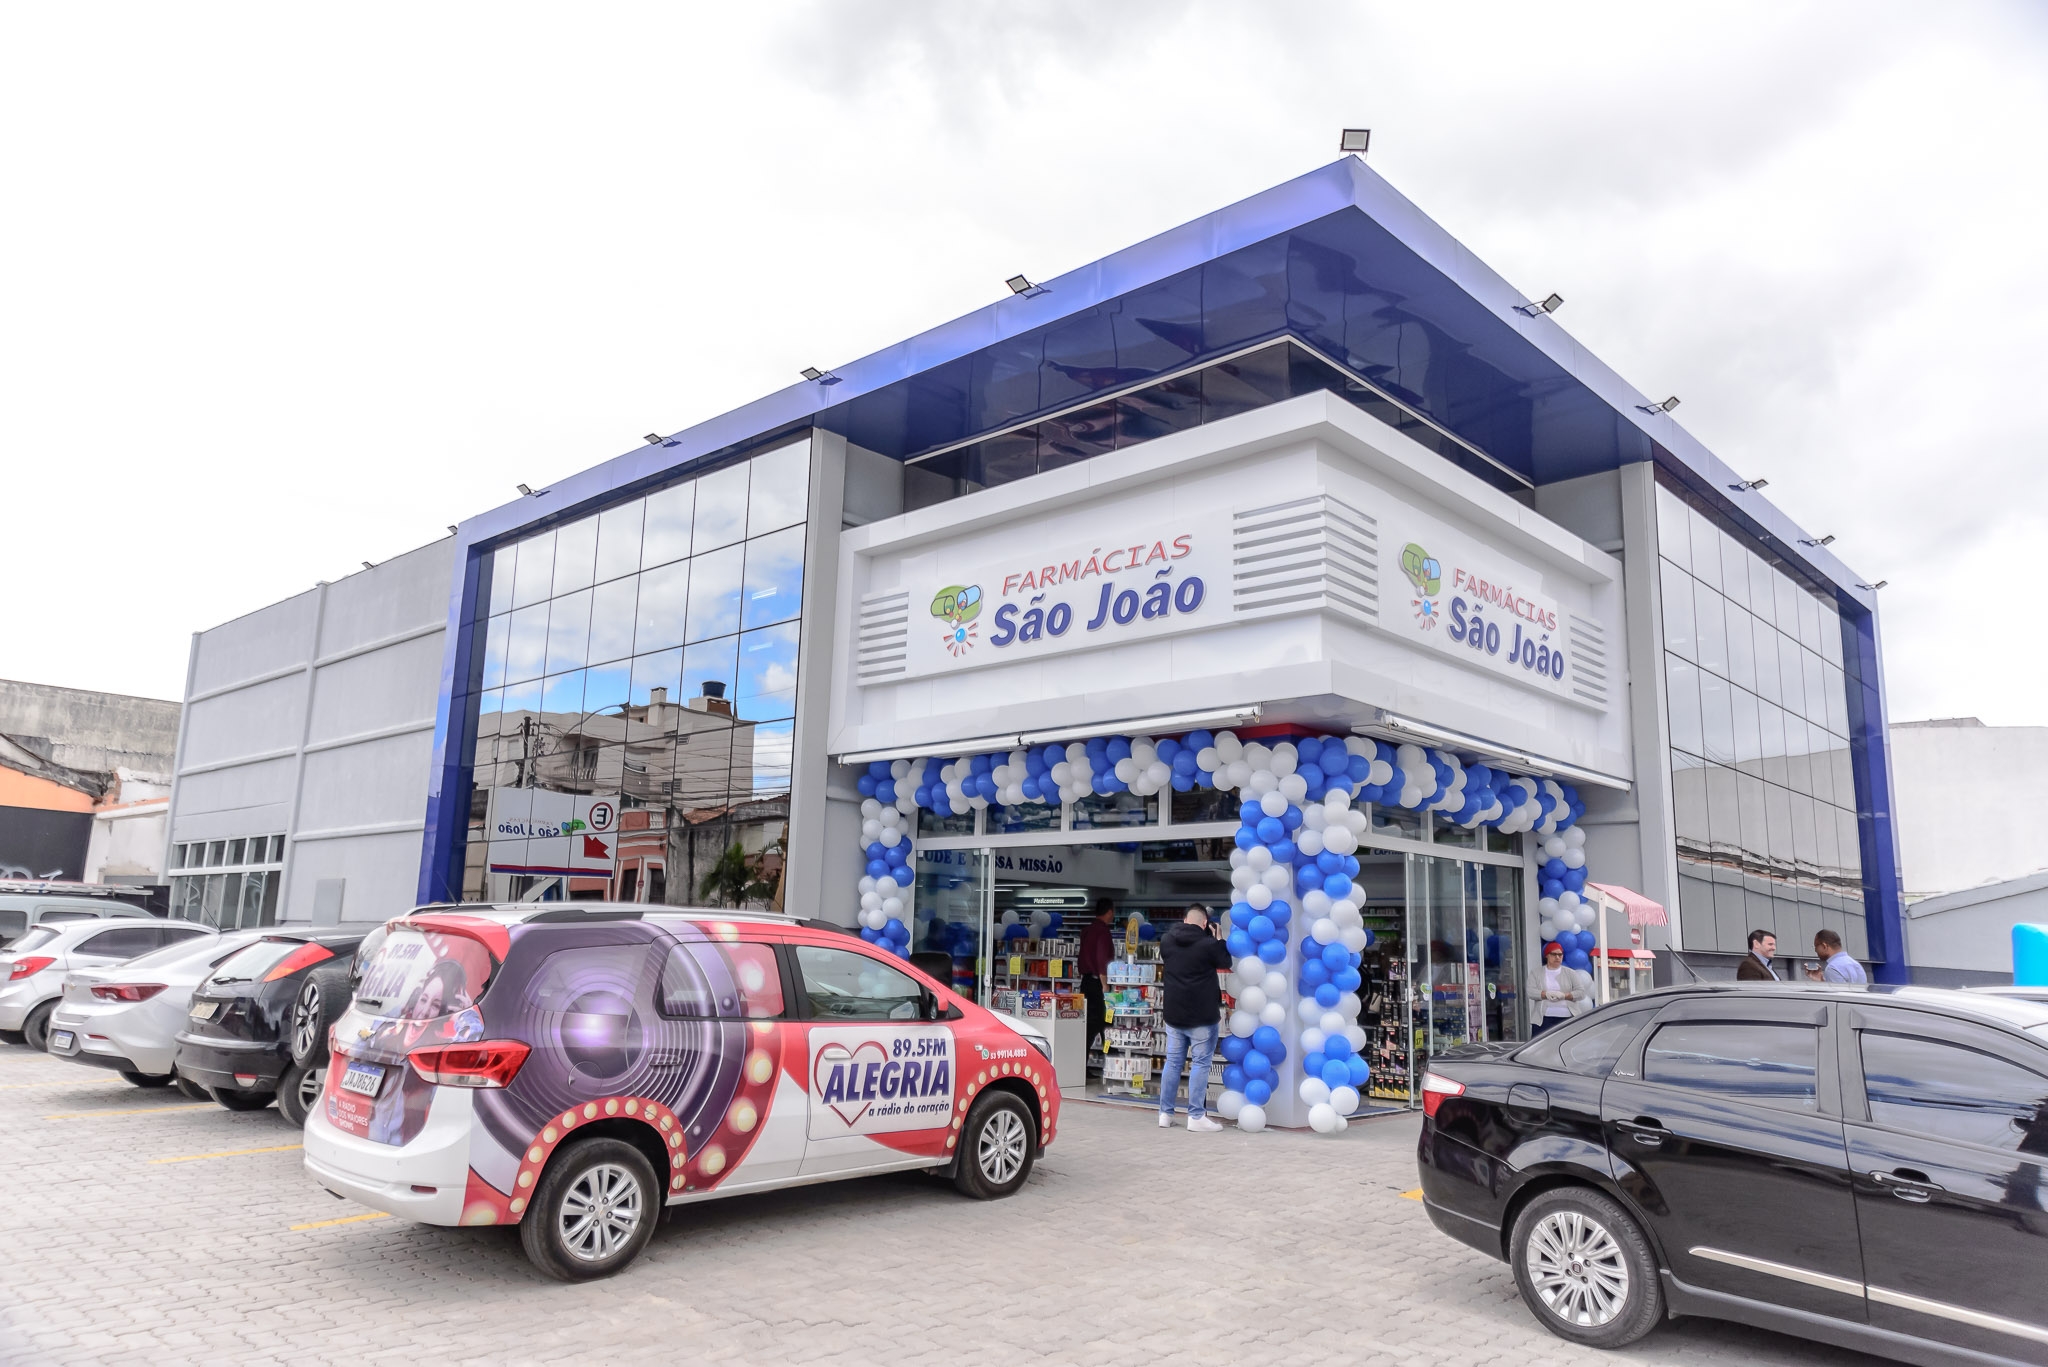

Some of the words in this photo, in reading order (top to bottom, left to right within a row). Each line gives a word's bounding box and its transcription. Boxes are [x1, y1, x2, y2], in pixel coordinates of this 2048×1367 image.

[1002, 534, 1193, 596] FARMÁCIAS
[990, 593, 1073, 647] São
[1087, 566, 1206, 632] João
[1453, 568, 1557, 631] FARMÁCIAS
[1448, 596, 1500, 656] São
[1508, 623, 1564, 681] João
[1019, 854, 1063, 873] MISSÃO
[1028, 1010, 1048, 1018] OFERTAS
[892, 1038, 947, 1058] 89.5FM
[822, 1060, 949, 1104] ALEGRIA
[868, 1108, 875, 1117] a
[877, 1103, 901, 1116] rádio
[903, 1101, 915, 1114] do
[917, 1100, 950, 1115] coração
